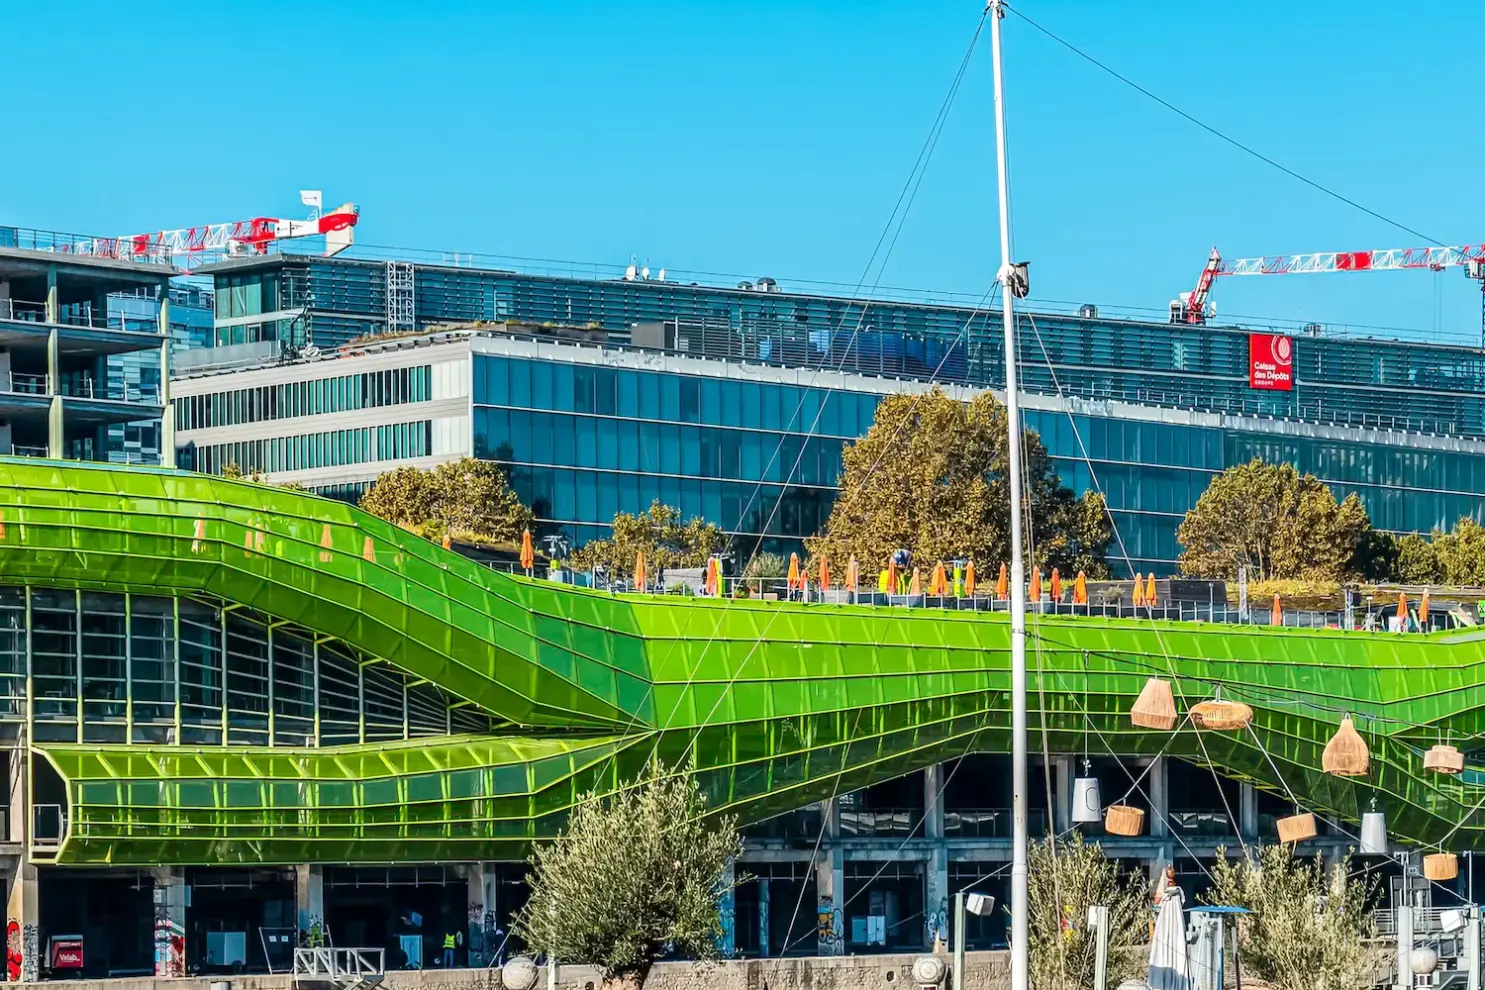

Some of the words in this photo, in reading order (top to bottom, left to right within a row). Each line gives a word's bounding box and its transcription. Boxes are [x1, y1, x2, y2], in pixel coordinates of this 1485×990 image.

[1254, 361, 1276, 371] Caisse
[1254, 370, 1266, 379] des
[1267, 371, 1289, 380] Dépôts
